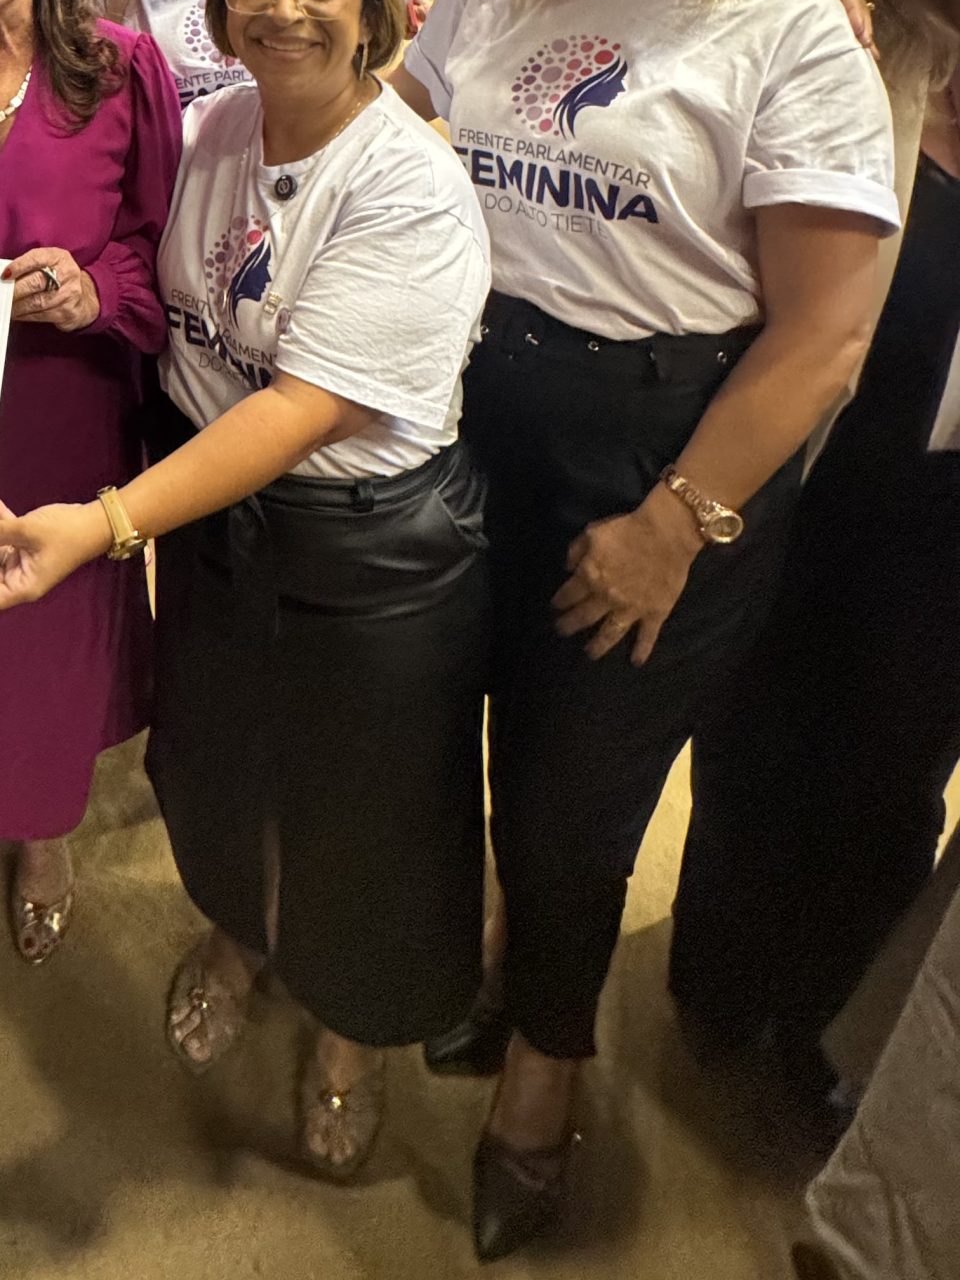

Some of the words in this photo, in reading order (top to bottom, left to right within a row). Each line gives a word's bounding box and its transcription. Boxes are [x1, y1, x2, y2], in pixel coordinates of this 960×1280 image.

[459, 128, 514, 152] FRENTE
[516, 139, 651, 189] PARLAMENTAR
[484, 193, 513, 213] DO
